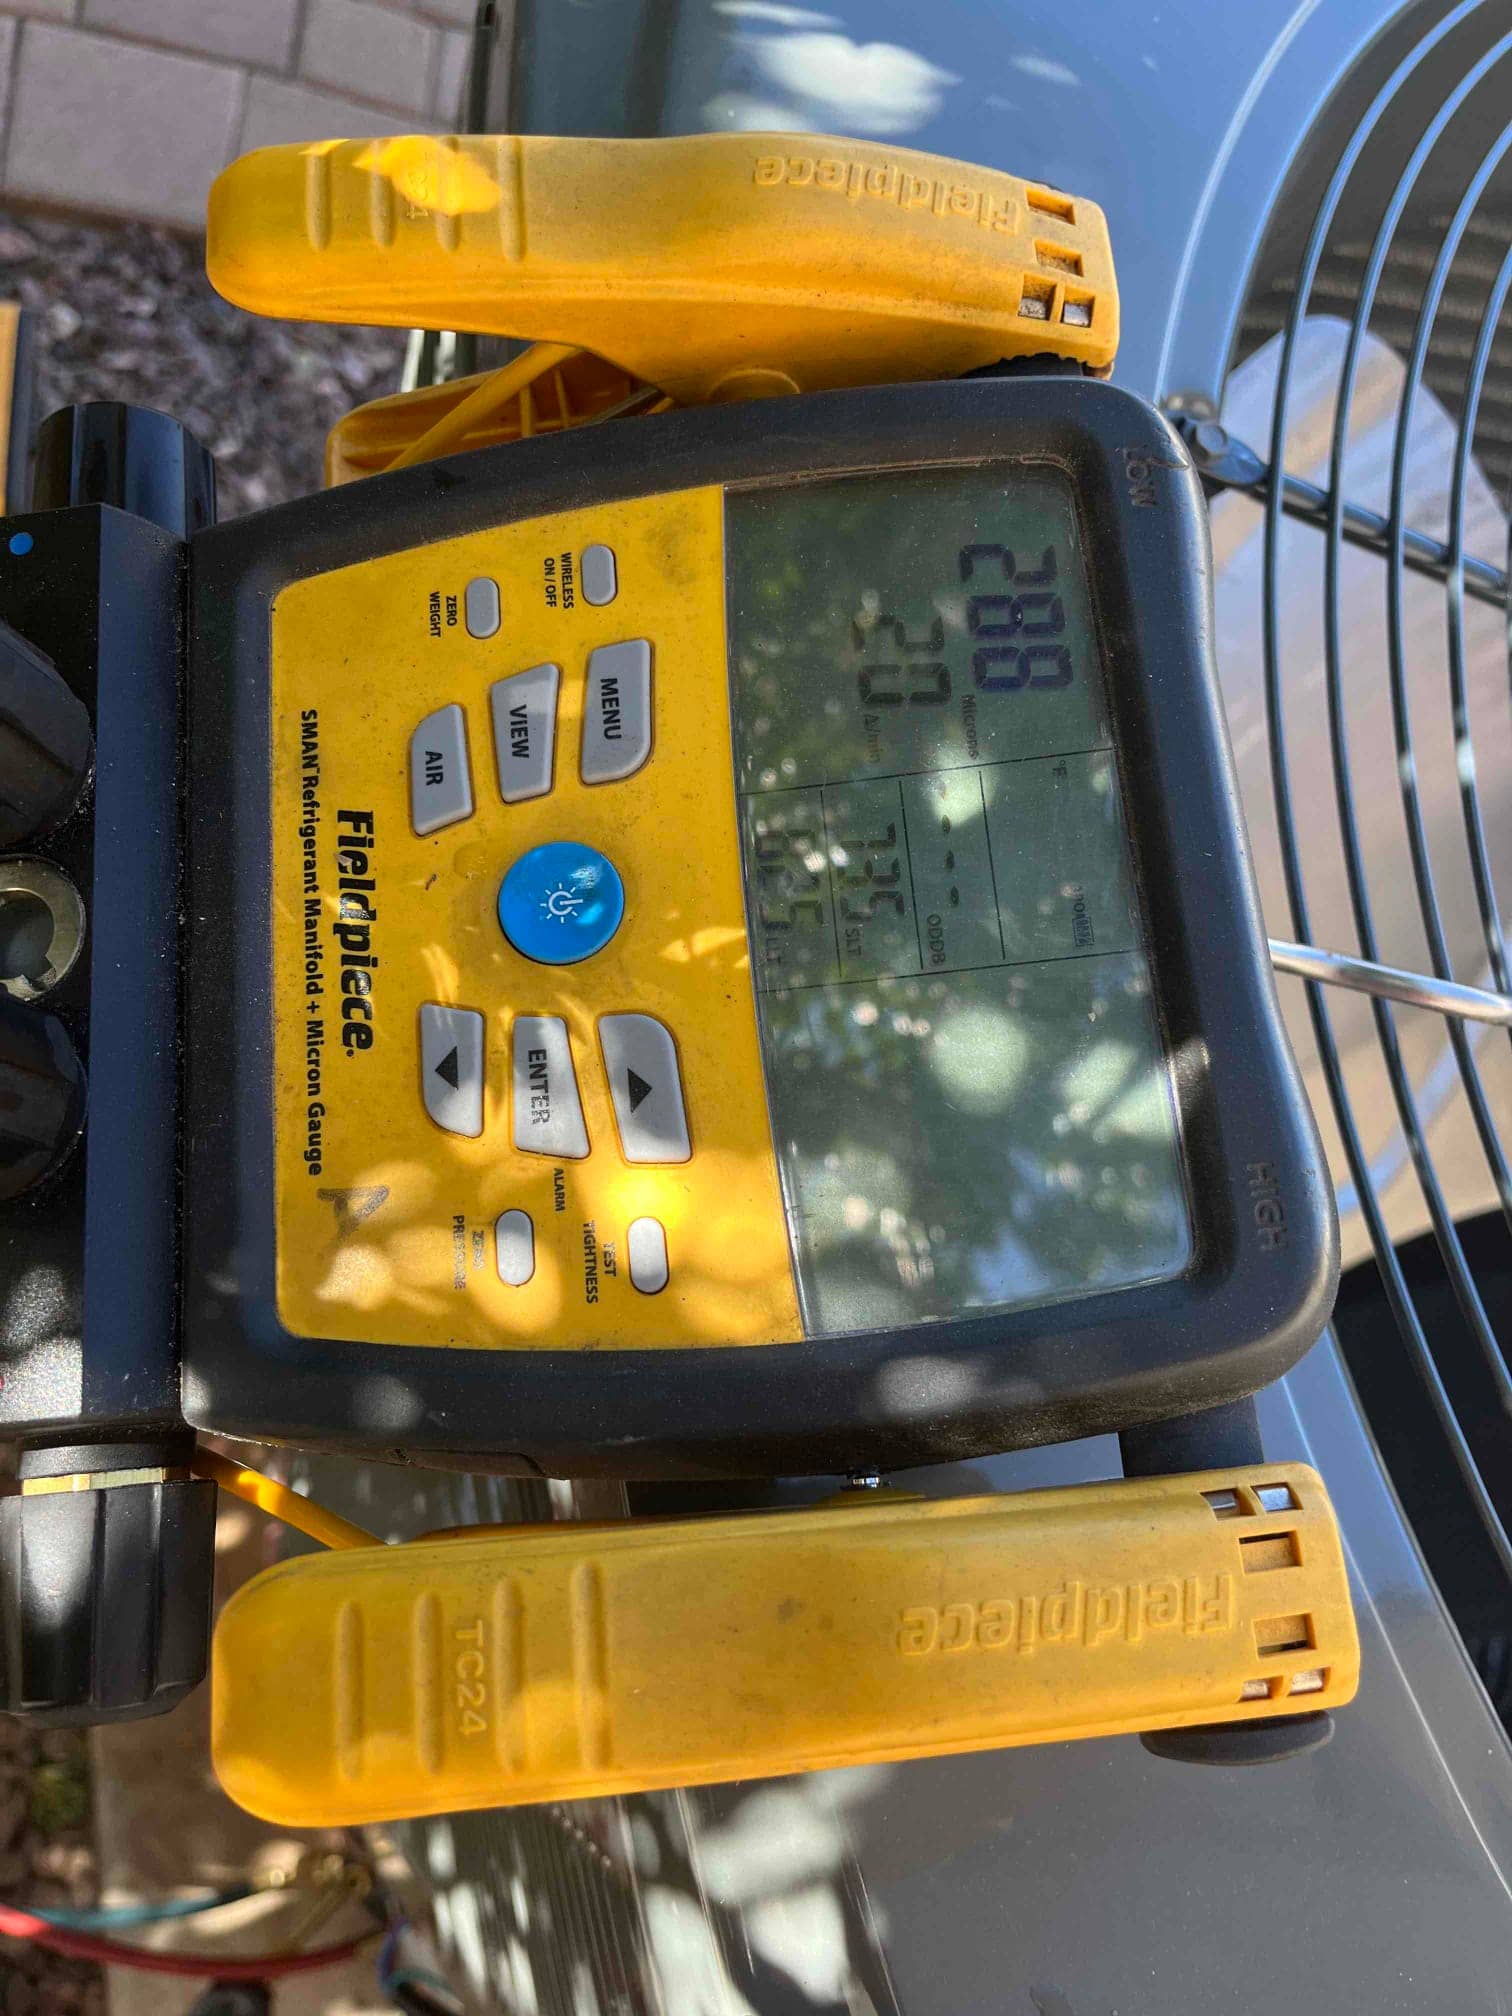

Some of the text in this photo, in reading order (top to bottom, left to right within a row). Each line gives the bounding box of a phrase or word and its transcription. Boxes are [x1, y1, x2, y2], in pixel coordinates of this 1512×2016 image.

[753, 155, 1022, 235] Fieldpiece
[544, 557, 555, 576] ON
[545, 584, 557, 607] OFF
[561, 552, 574, 609] WIRELESS
[430, 591, 441, 637] WEIGHT
[446, 595, 458, 626] ZERO
[960, 544, 1074, 694] 288
[850, 614, 953, 708] 20
[509, 705, 529, 759] VIEW
[600, 678, 621, 740] MENU
[960, 695, 979, 759] Microns
[424, 750, 445, 786] AIR
[298, 774, 320, 894] Refrigerant
[303, 898, 324, 995] Manifold
[332, 809, 379, 1050] Fieldpiece
[844, 927, 861, 956] SLT
[306, 1020, 325, 1096] Micron
[527, 1049, 551, 1124] ENTER
[303, 1102, 326, 1177] Gauge
[553, 1167, 565, 1212] ALARM
[1246, 1162, 1288, 1254] HIGH
[583, 1220, 598, 1304] TIGHTNESS
[603, 1242, 616, 1277] TEST
[898, 1574, 1236, 1657] Fieldpiece
[455, 1618, 488, 1737] TC24
